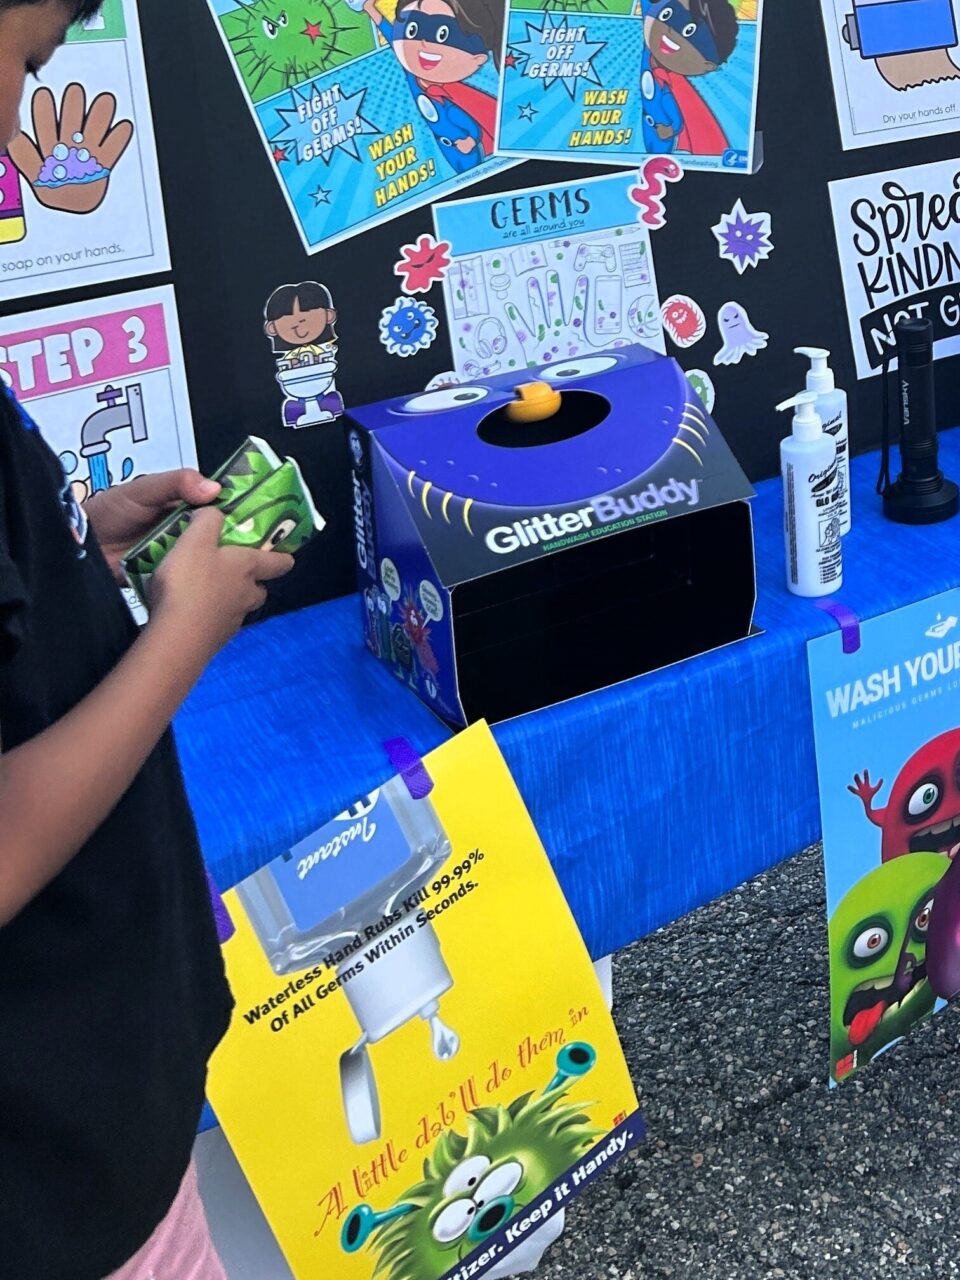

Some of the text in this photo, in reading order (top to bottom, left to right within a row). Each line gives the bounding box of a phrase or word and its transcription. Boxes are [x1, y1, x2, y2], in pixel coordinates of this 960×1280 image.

[541, 25, 586, 45] FIGHT
[546, 43, 575, 61] OFF
[528, 60, 590, 79] GERMS!
[297, 82, 343, 123] FIGHT
[581, 108, 622, 126] YOUR
[583, 88, 629, 106] WASH
[882, 114, 897, 124] Dry
[898, 111, 917, 122] your
[917, 106, 943, 117] hands
[302, 115, 363, 162] GERMS!
[311, 107, 340, 134] OFF
[368, 122, 415, 161] WASH
[568, 128, 632, 148] HANDS!
[374, 159, 437, 208] HANDS!
[375, 145, 418, 181] YOUR
[490, 187, 591, 230] GERMS
[502, 217, 586, 240] are all around you
[1, 243, 125, 271] soap on your hands.
[121, 314, 149, 364] 3
[352, 469, 368, 569] Glitter
[484, 477, 700, 554] GlitterBuddy
[543, 509, 669, 551] HANDWASH EDUCATION STATION
[825, 664, 902, 718] WASH
[852, 702, 907, 729] MALICIOUS
[911, 687, 943, 705] GERMS
[297, 816, 377, 881] Instant
[243, 848, 485, 1026] Waterless Hand Rubs Kill 99.99%
[270, 880, 480, 1033] Of All Germs Within Seconds.
[353, 1138, 409, 1199] little
[415, 1075, 481, 1150] dab'll
[485, 1061, 512, 1094] do
[517, 1026, 567, 1070] them
[568, 1005, 590, 1028] in
[505, 1198, 554, 1244] Keep
[551, 1183, 572, 1204] it
[571, 1130, 635, 1186] Handy.
